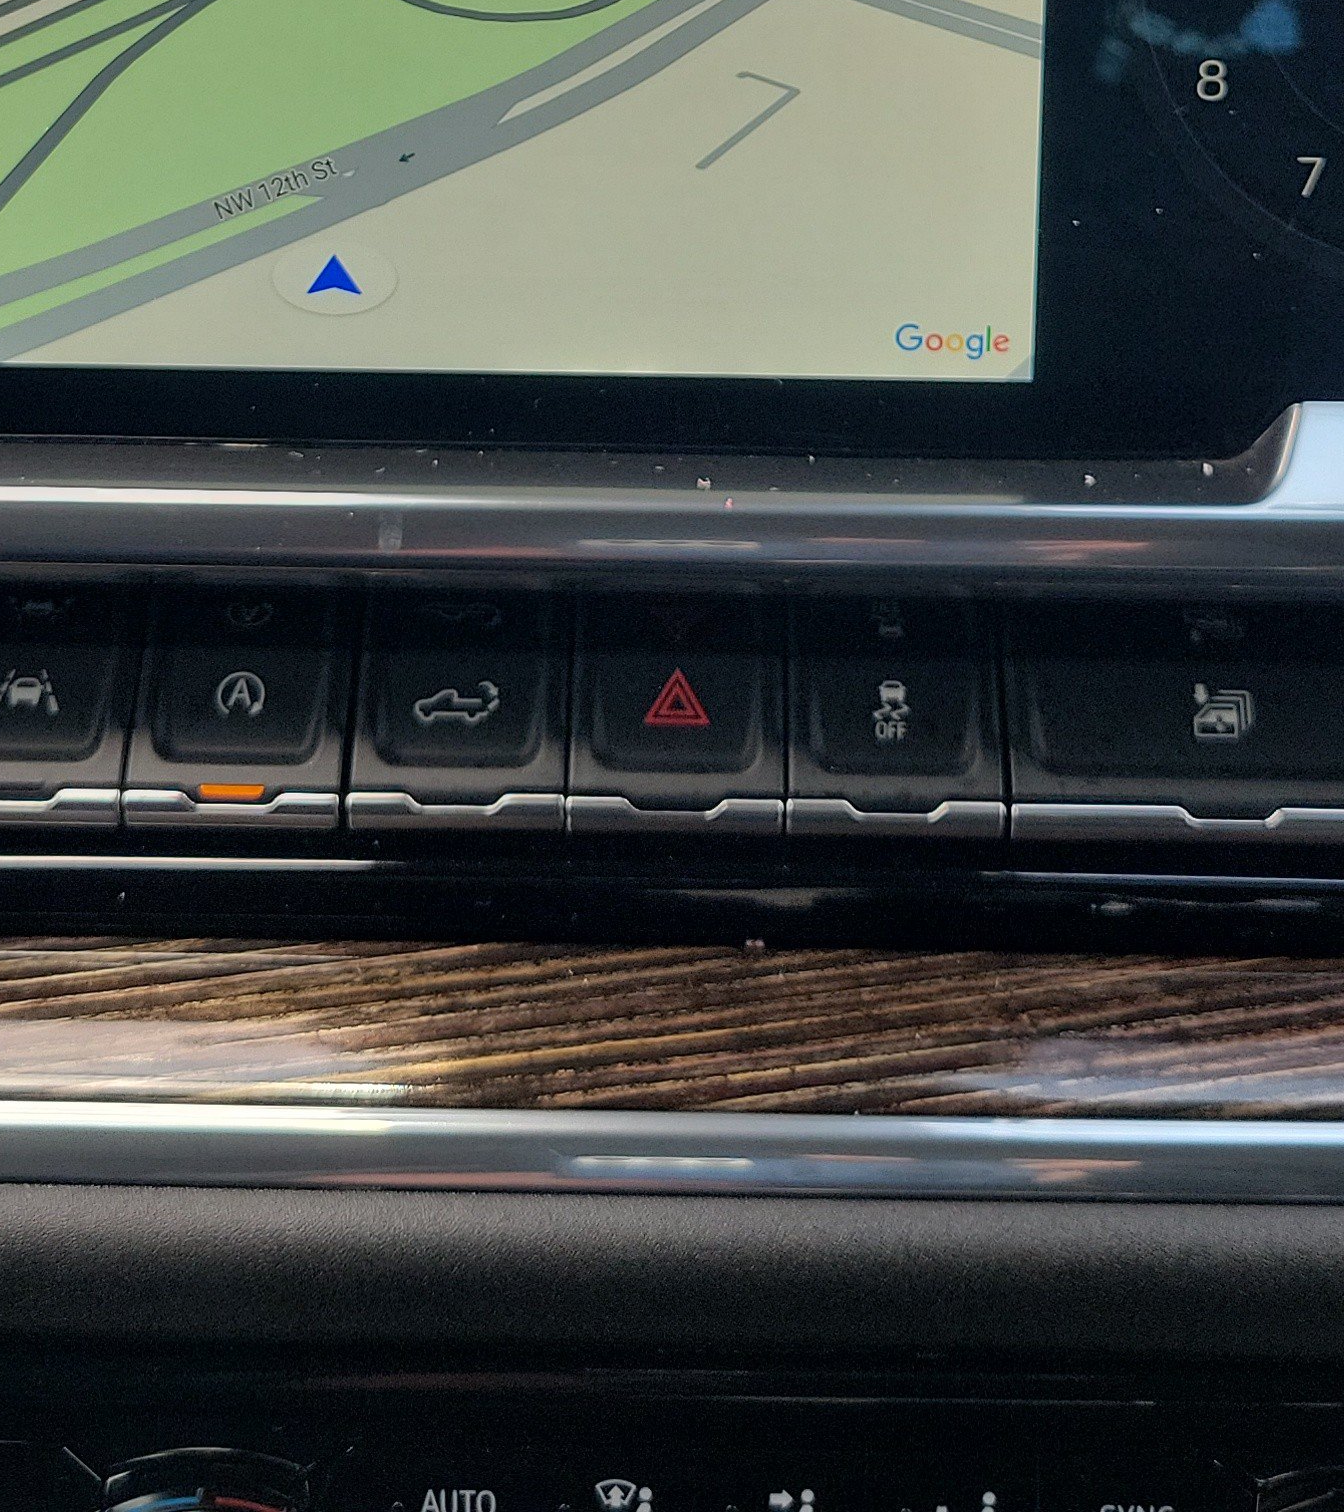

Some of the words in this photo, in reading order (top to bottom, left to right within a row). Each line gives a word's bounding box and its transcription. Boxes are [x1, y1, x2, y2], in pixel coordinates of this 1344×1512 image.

[1196, 60, 1229, 102] 8
[213, 188, 254, 220] NW
[258, 170, 309, 201] 12th
[311, 158, 338, 180] St
[1297, 156, 1326, 197] 7
[894, 323, 1011, 361] Google
[227, 677, 252, 707] A
[874, 720, 908, 740] OFF
[420, 1488, 497, 1512] AUTO
